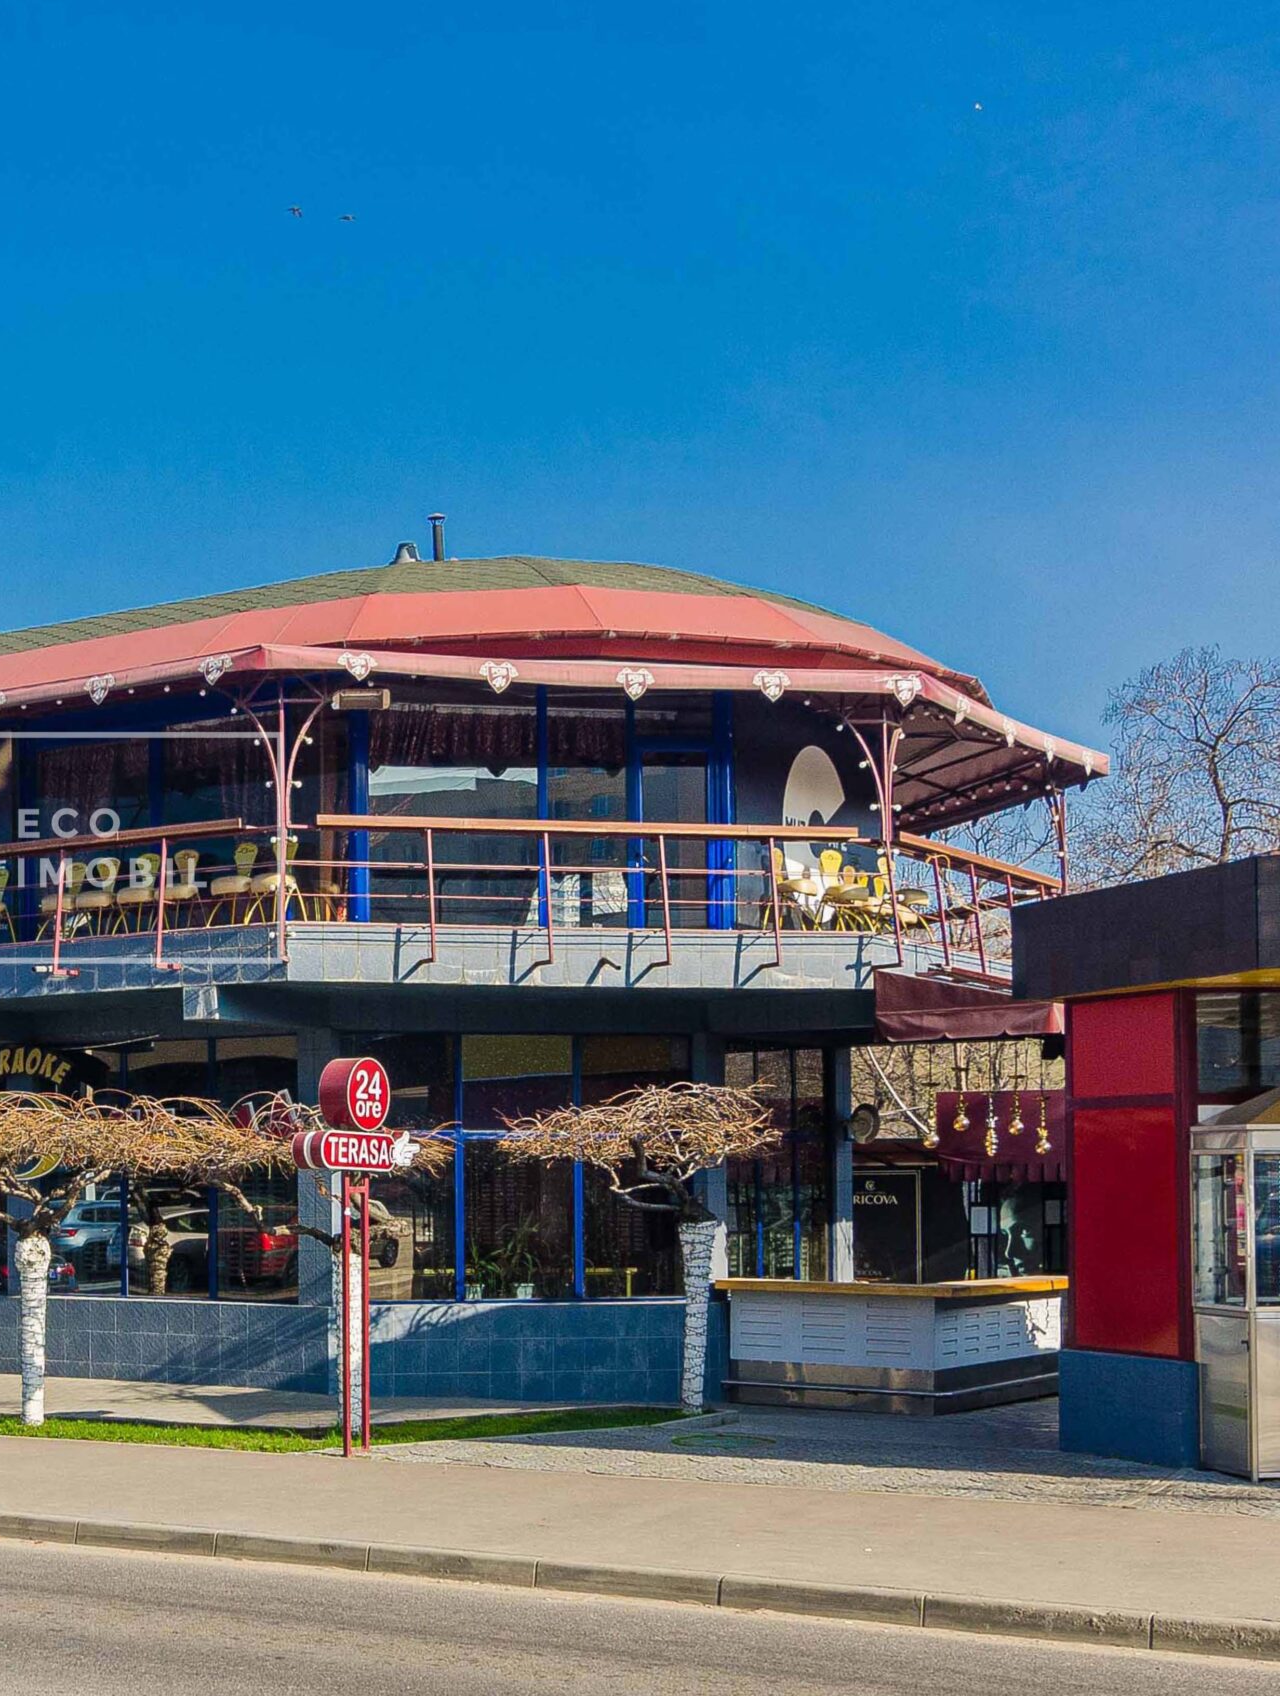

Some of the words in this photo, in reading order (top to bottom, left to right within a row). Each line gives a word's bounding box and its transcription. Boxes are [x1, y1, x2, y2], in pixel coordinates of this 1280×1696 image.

[355, 1069, 382, 1100] 24
[355, 1100, 382, 1118] ore
[327, 1136, 390, 1166] TERASA
[853, 1194, 898, 1205] RICOVA
